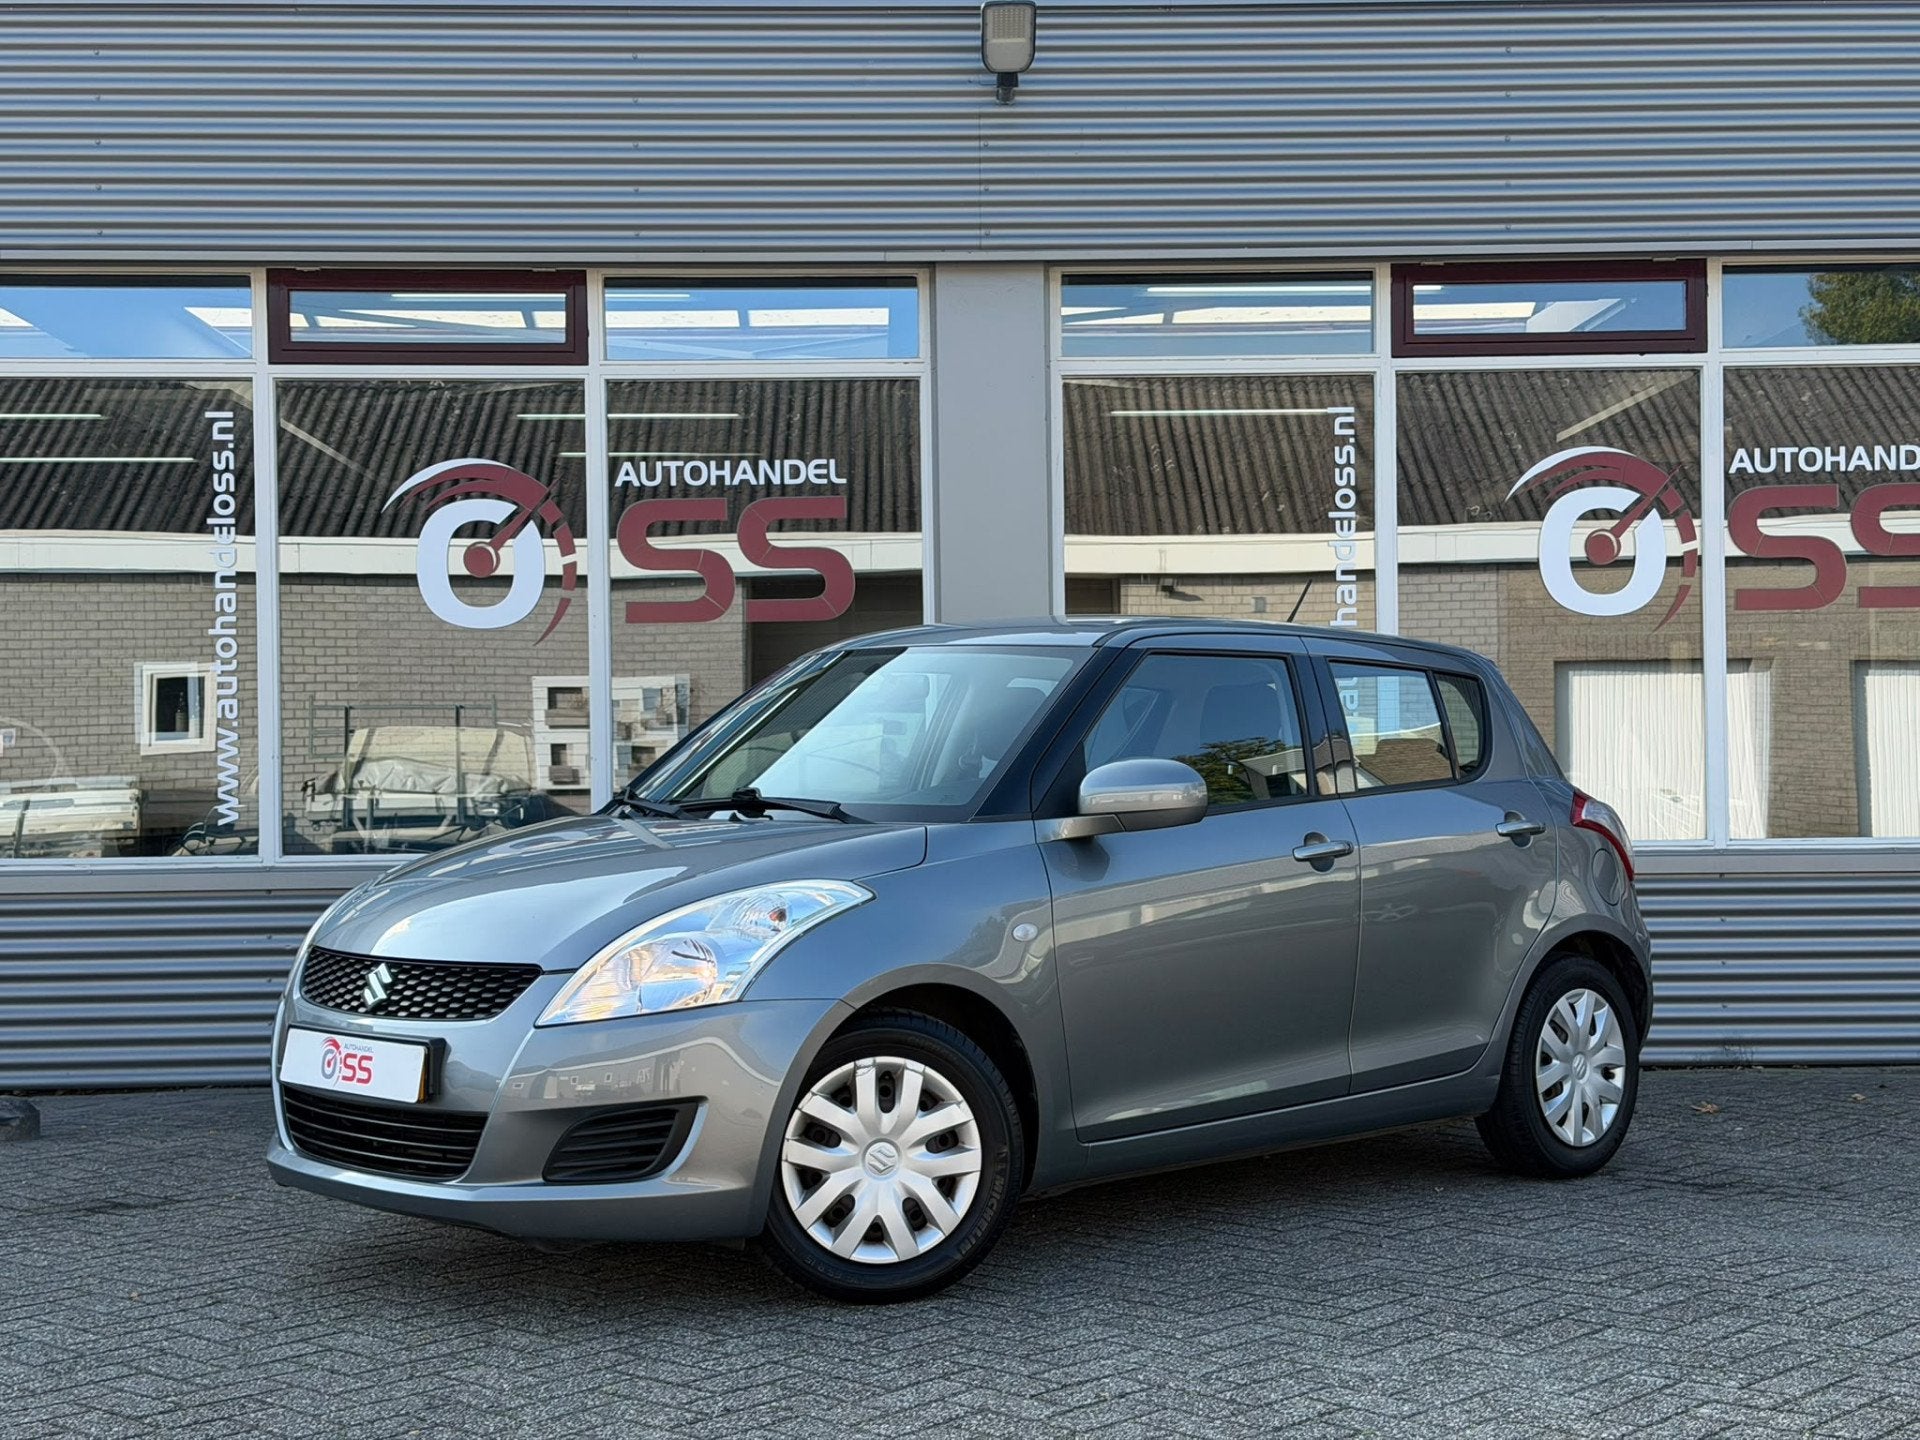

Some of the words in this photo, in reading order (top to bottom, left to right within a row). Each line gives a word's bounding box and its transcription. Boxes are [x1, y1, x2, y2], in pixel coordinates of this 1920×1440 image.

[614, 459, 847, 487] AUTOHANDEL
[205, 411, 239, 826] www.autohandeloss.nl
[344, 1043, 374, 1053] AUTOHANDEL
[959, 1173, 1006, 1256] MICHELIN
